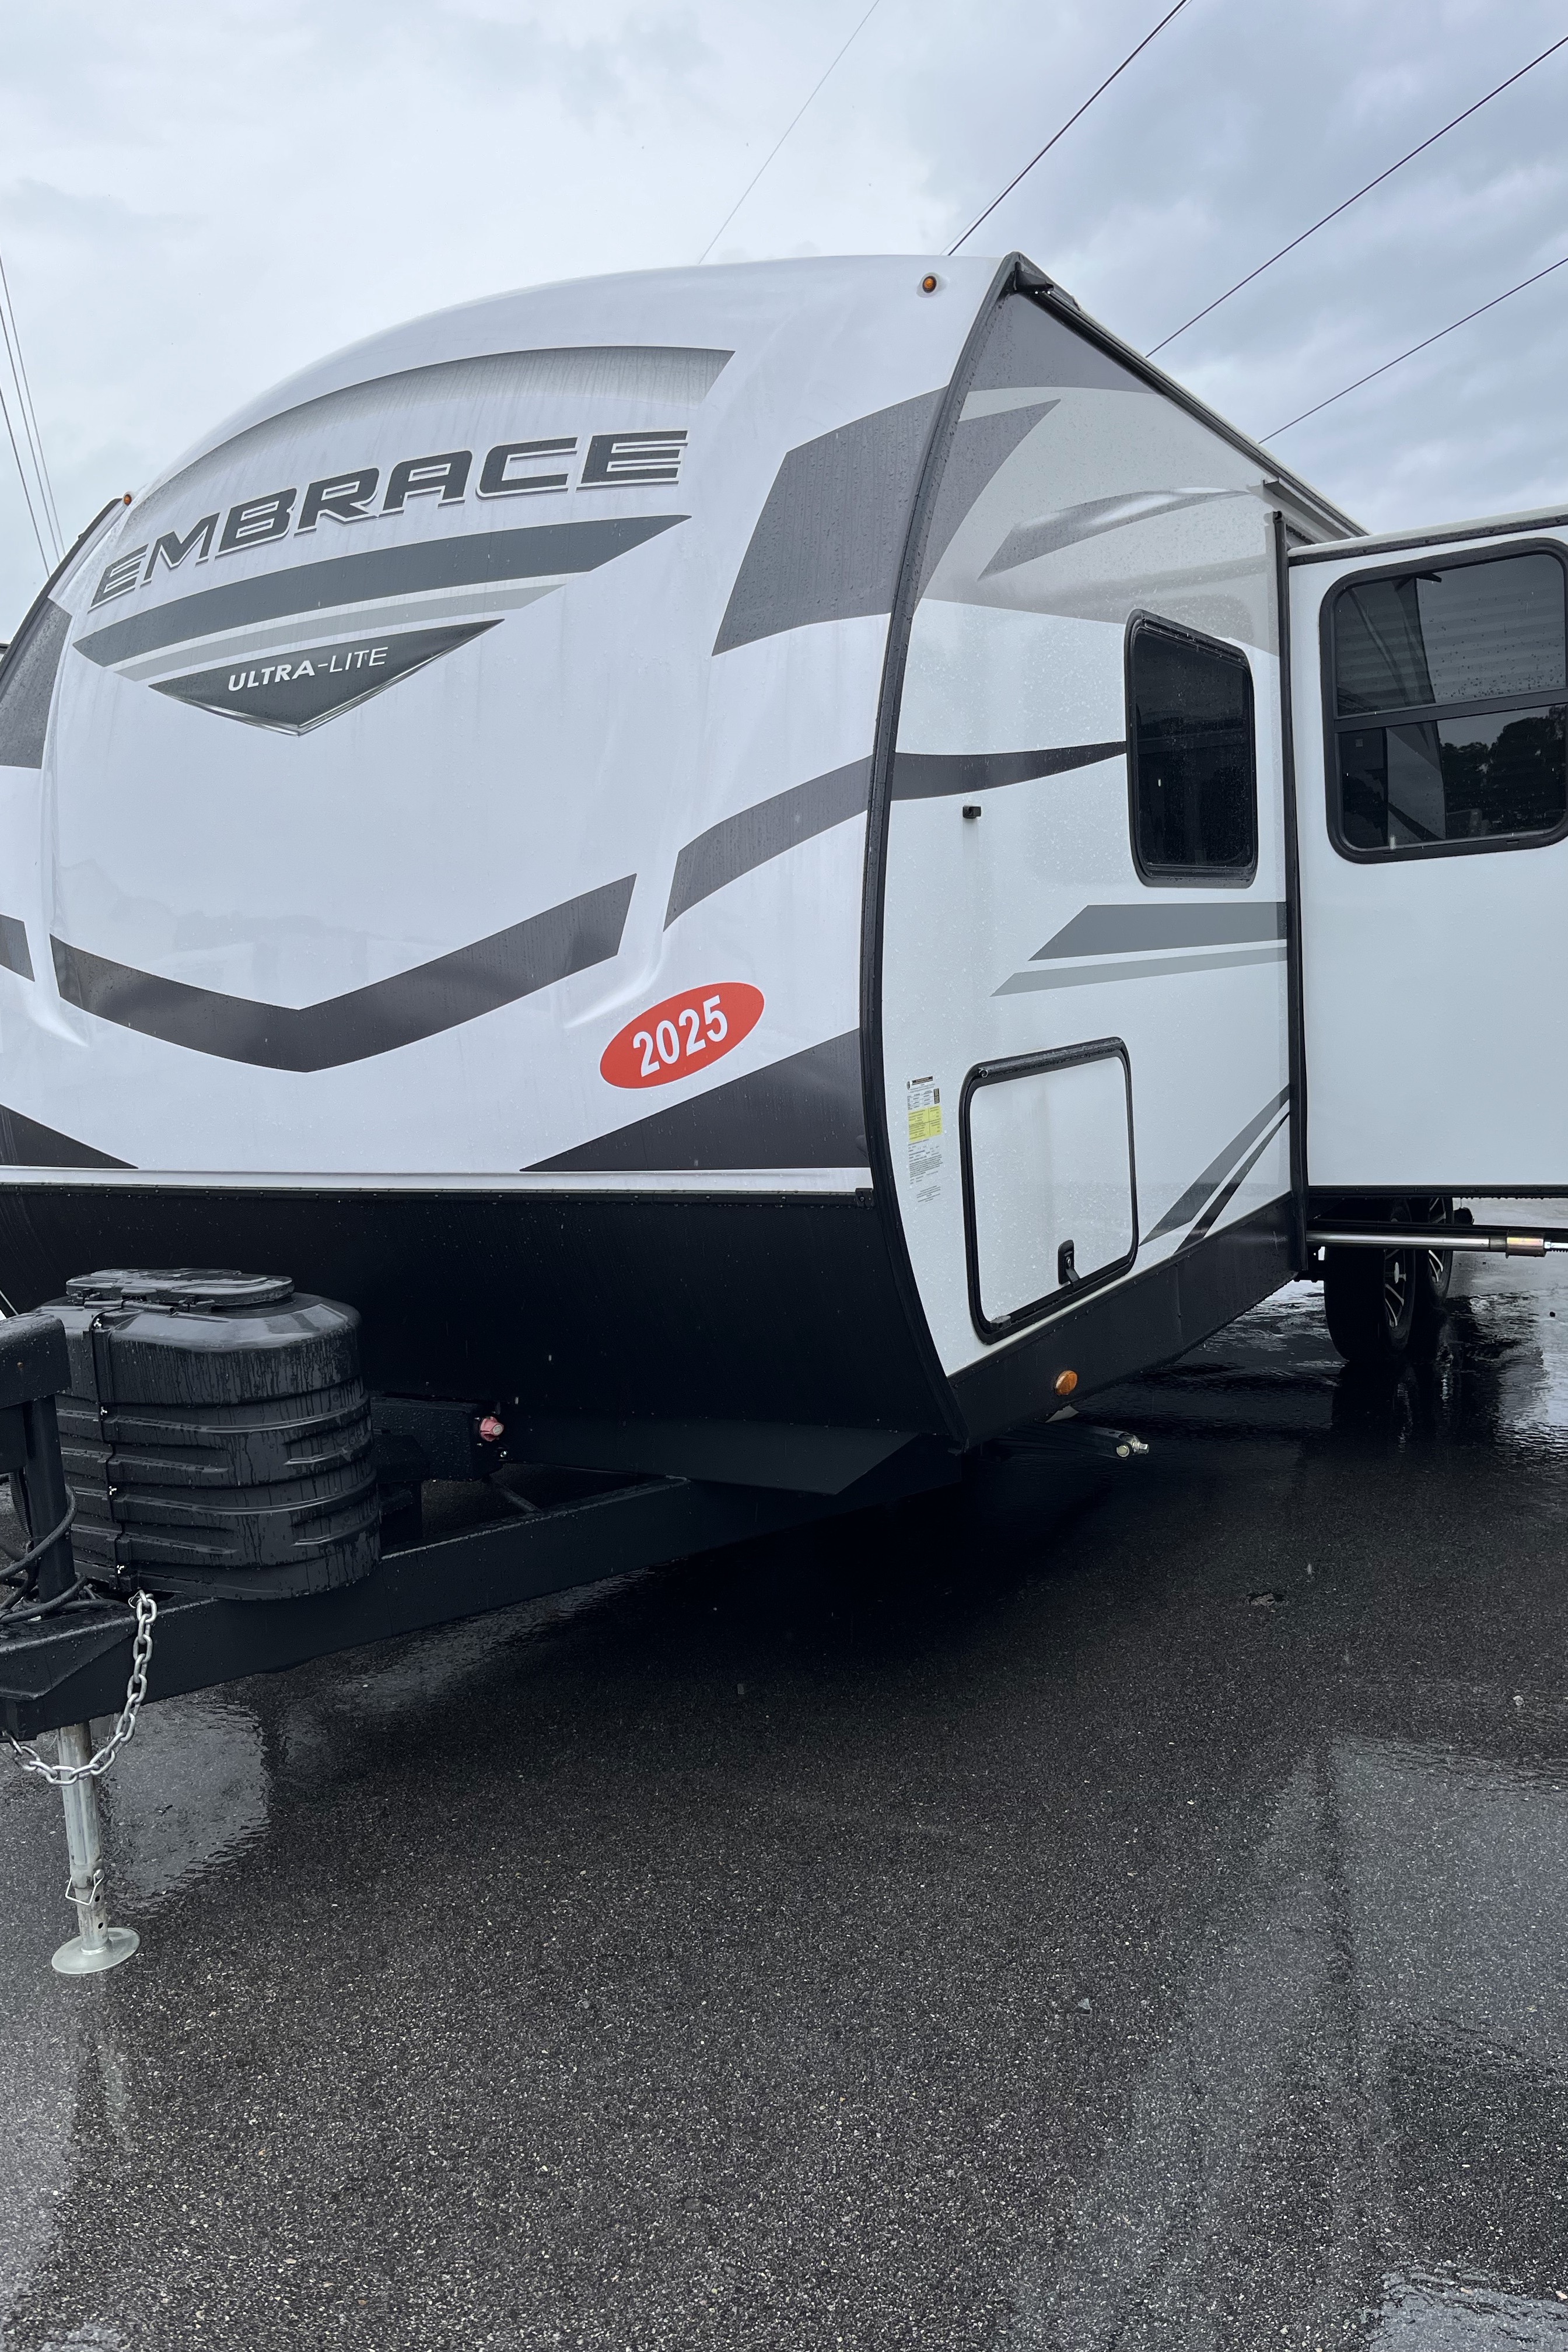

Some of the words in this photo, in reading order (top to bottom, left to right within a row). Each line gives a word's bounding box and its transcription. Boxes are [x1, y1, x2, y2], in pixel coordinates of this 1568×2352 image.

[88, 430, 689, 614] EMBRACE
[228, 646, 388, 692] ULTRA-LITE
[633, 995, 728, 1077] 2025
